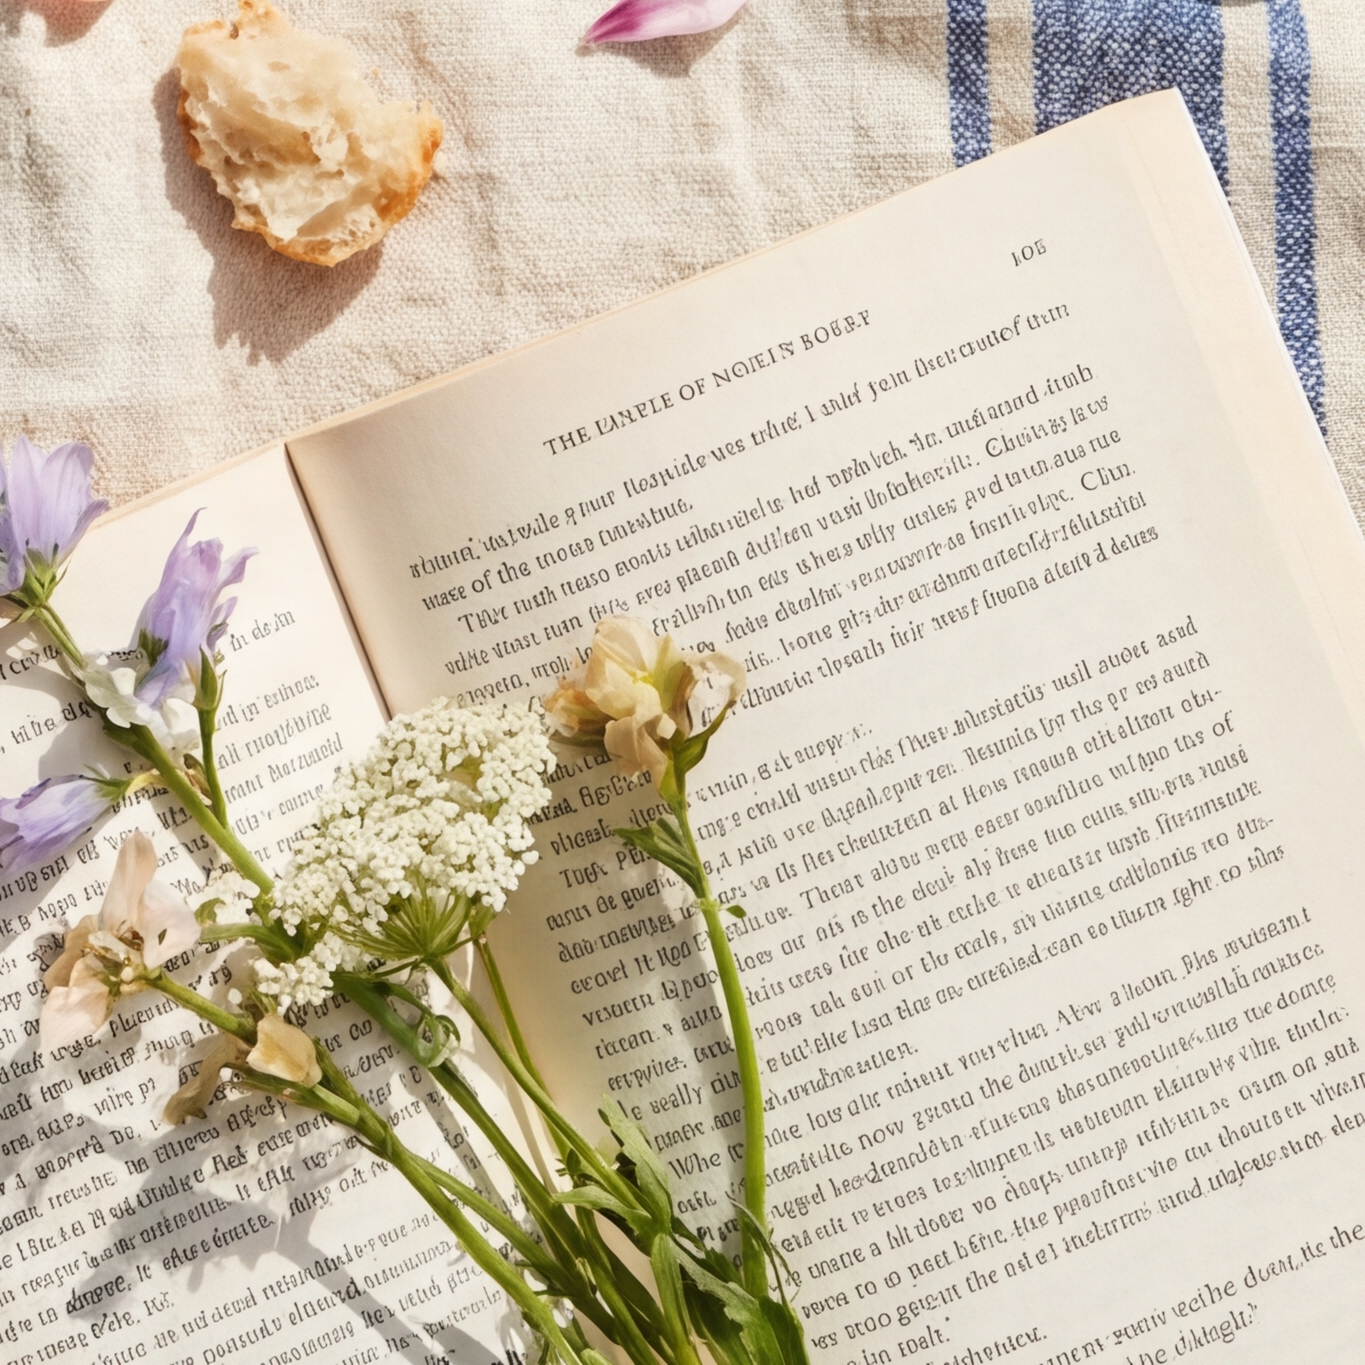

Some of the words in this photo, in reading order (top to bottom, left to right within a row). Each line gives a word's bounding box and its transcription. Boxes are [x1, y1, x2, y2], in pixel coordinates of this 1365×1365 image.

[542, 426, 592, 456] THE
[678, 377, 706, 401] OF
[471, 568, 493, 594] of
[496, 561, 532, 585] the
[871, 894, 906, 919] the
[857, 1119, 904, 1151] now
[978, 1074, 1014, 1100] the
[965, 1269, 999, 1294] the
